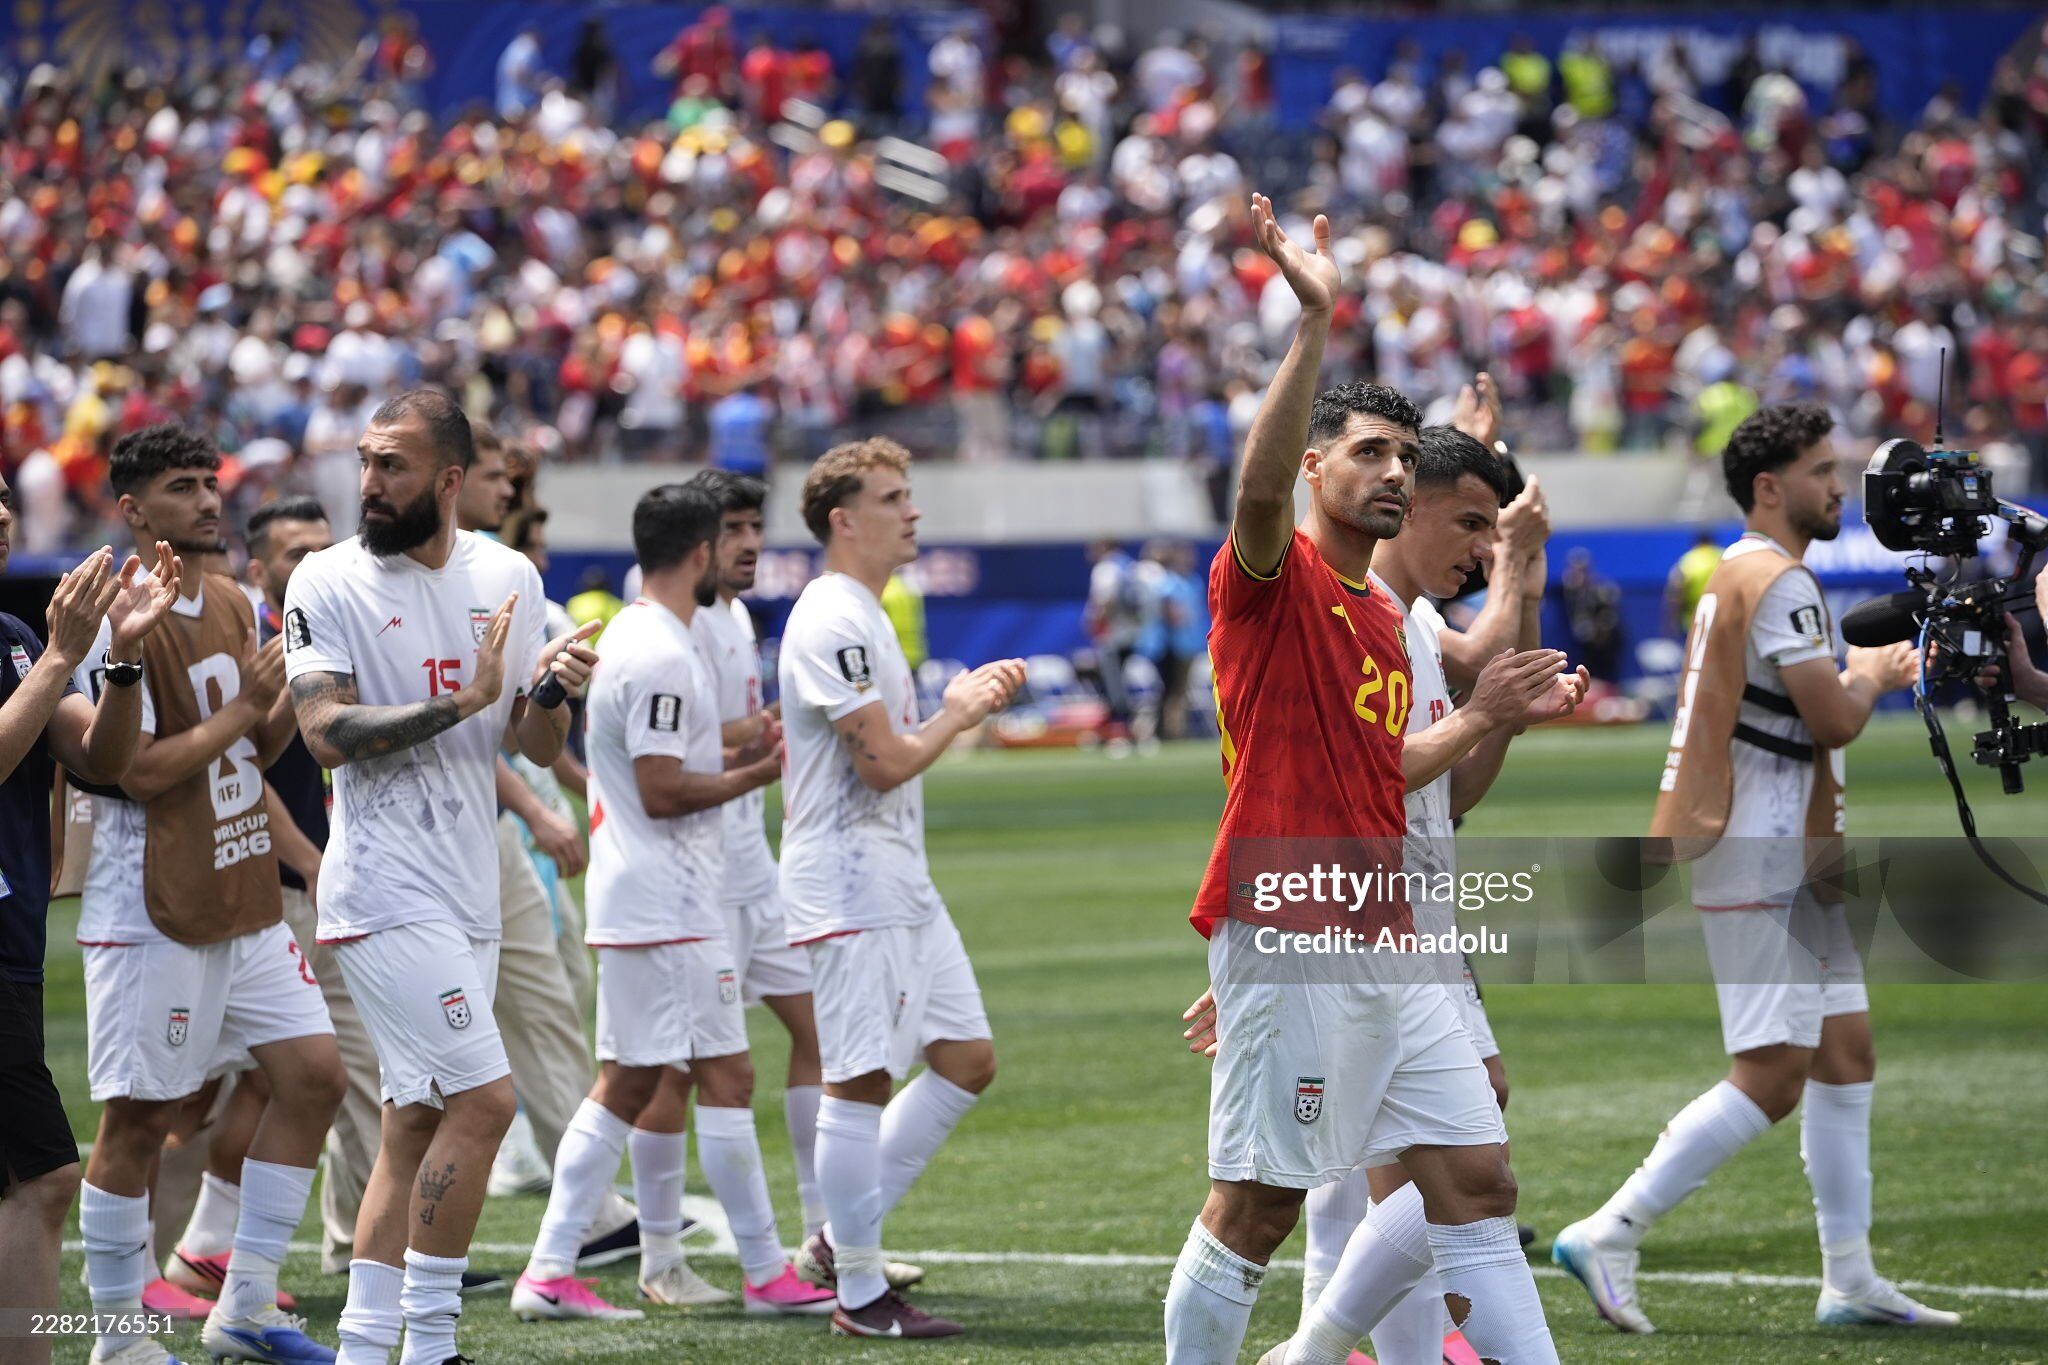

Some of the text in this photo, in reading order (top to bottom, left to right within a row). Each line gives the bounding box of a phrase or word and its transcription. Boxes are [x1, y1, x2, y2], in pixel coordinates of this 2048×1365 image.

[422, 658, 461, 697] 15
[1354, 655, 1408, 737] 20
[214, 831, 272, 870] 2026
